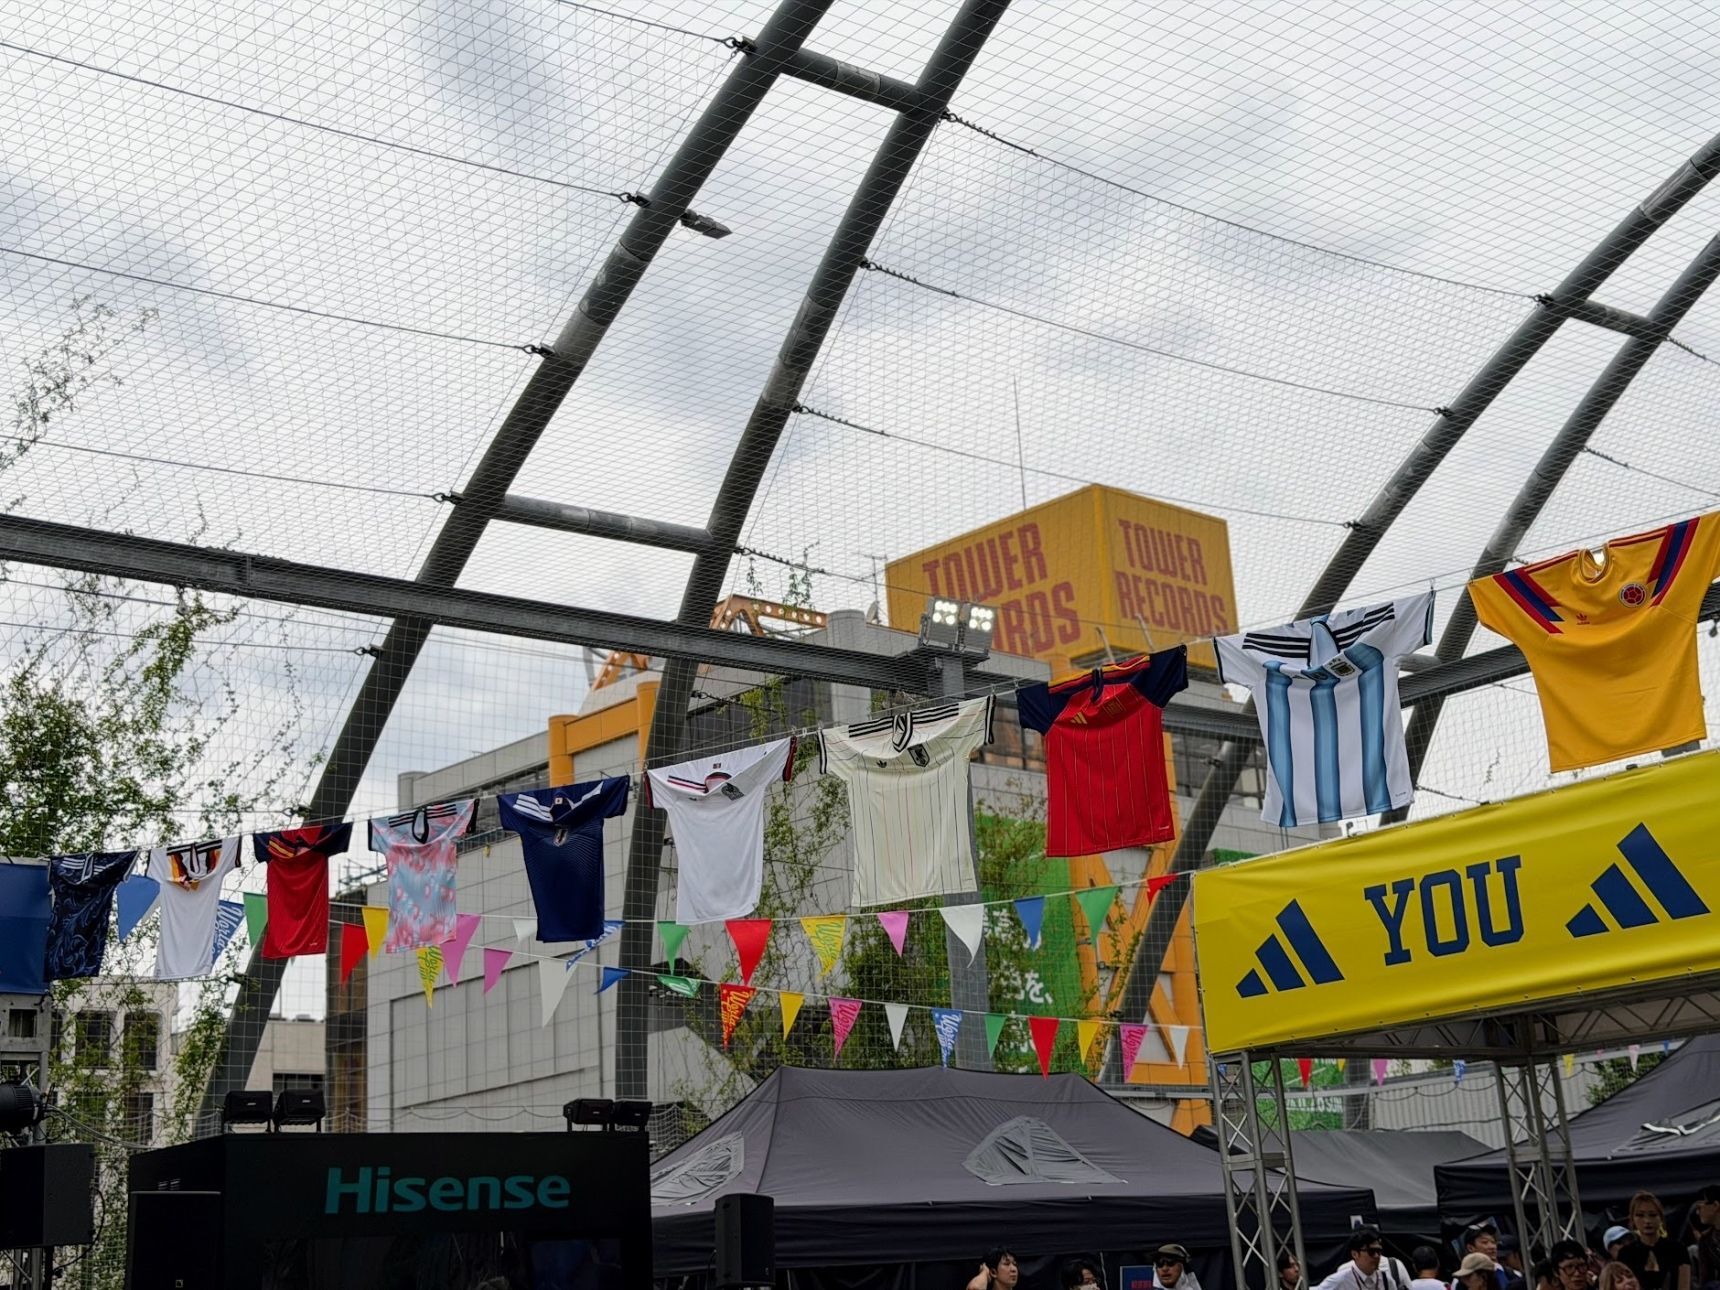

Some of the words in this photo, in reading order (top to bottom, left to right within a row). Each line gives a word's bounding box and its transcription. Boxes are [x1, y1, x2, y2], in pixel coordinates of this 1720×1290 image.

[923, 522, 1047, 603] TOWER
[1118, 519, 1207, 586] TOWER
[1114, 570, 1228, 635] RECORDS
[1364, 855, 1524, 966] YOU
[324, 1166, 571, 1214] Hisense
